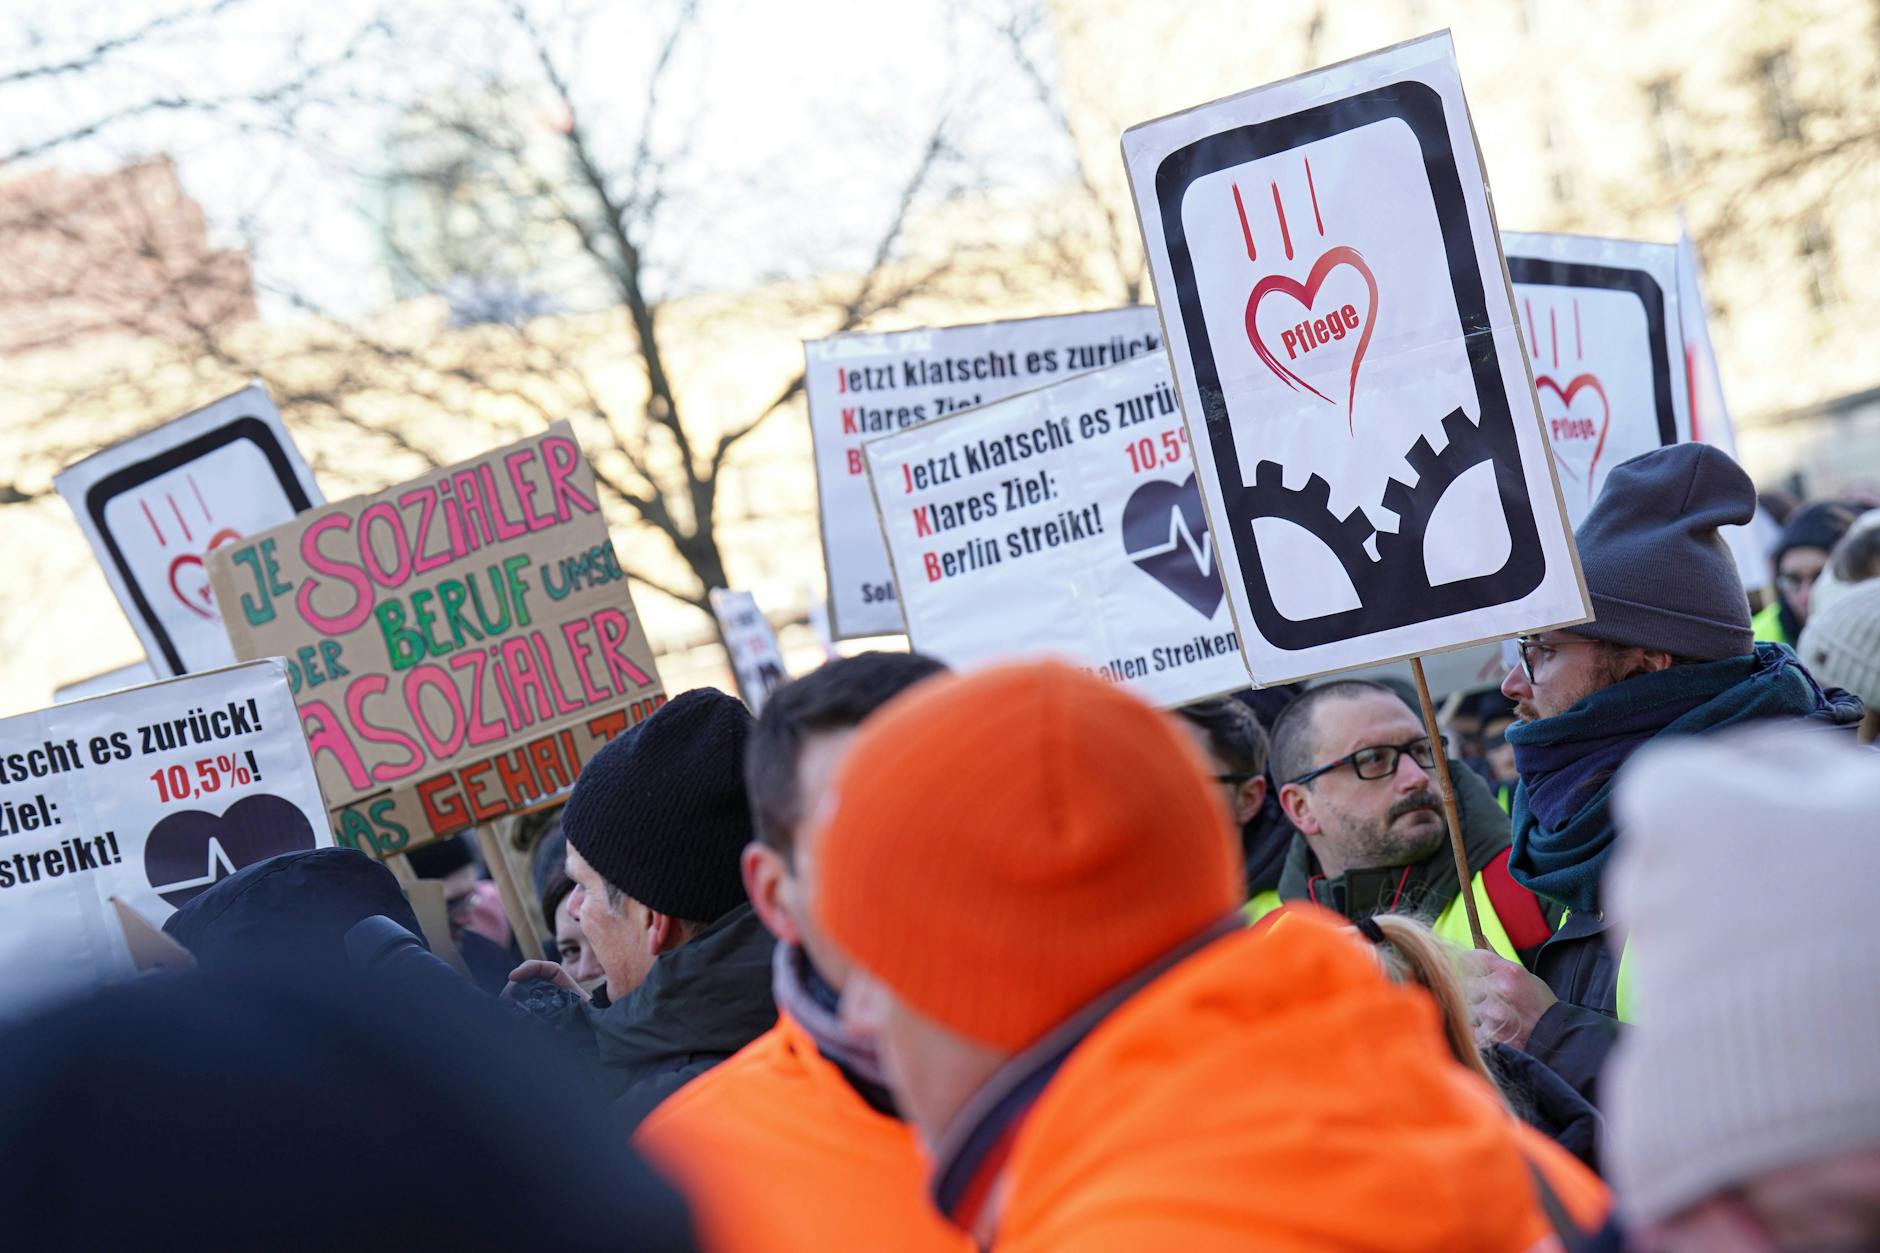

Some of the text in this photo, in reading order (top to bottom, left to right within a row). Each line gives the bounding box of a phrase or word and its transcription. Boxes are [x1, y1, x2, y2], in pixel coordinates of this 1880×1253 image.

[1281, 304, 1360, 360] Pflege
[838, 365, 897, 394] Jetzt
[903, 350, 1017, 388] klatscht
[1027, 349, 1059, 375] es
[842, 404, 927, 436] Klares
[902, 382, 1180, 494] Jetzt klatscht es zurü
[913, 470, 1059, 539] Klares Ziel:
[923, 504, 1104, 583] Berlin streikt!
[233, 537, 293, 627] JE
[374, 553, 533, 671] BERUF
[89, 731, 132, 764] es
[138, 698, 262, 754] zurück!
[150, 750, 262, 803] 10,5%!
[0, 831, 122, 889] streikt!
